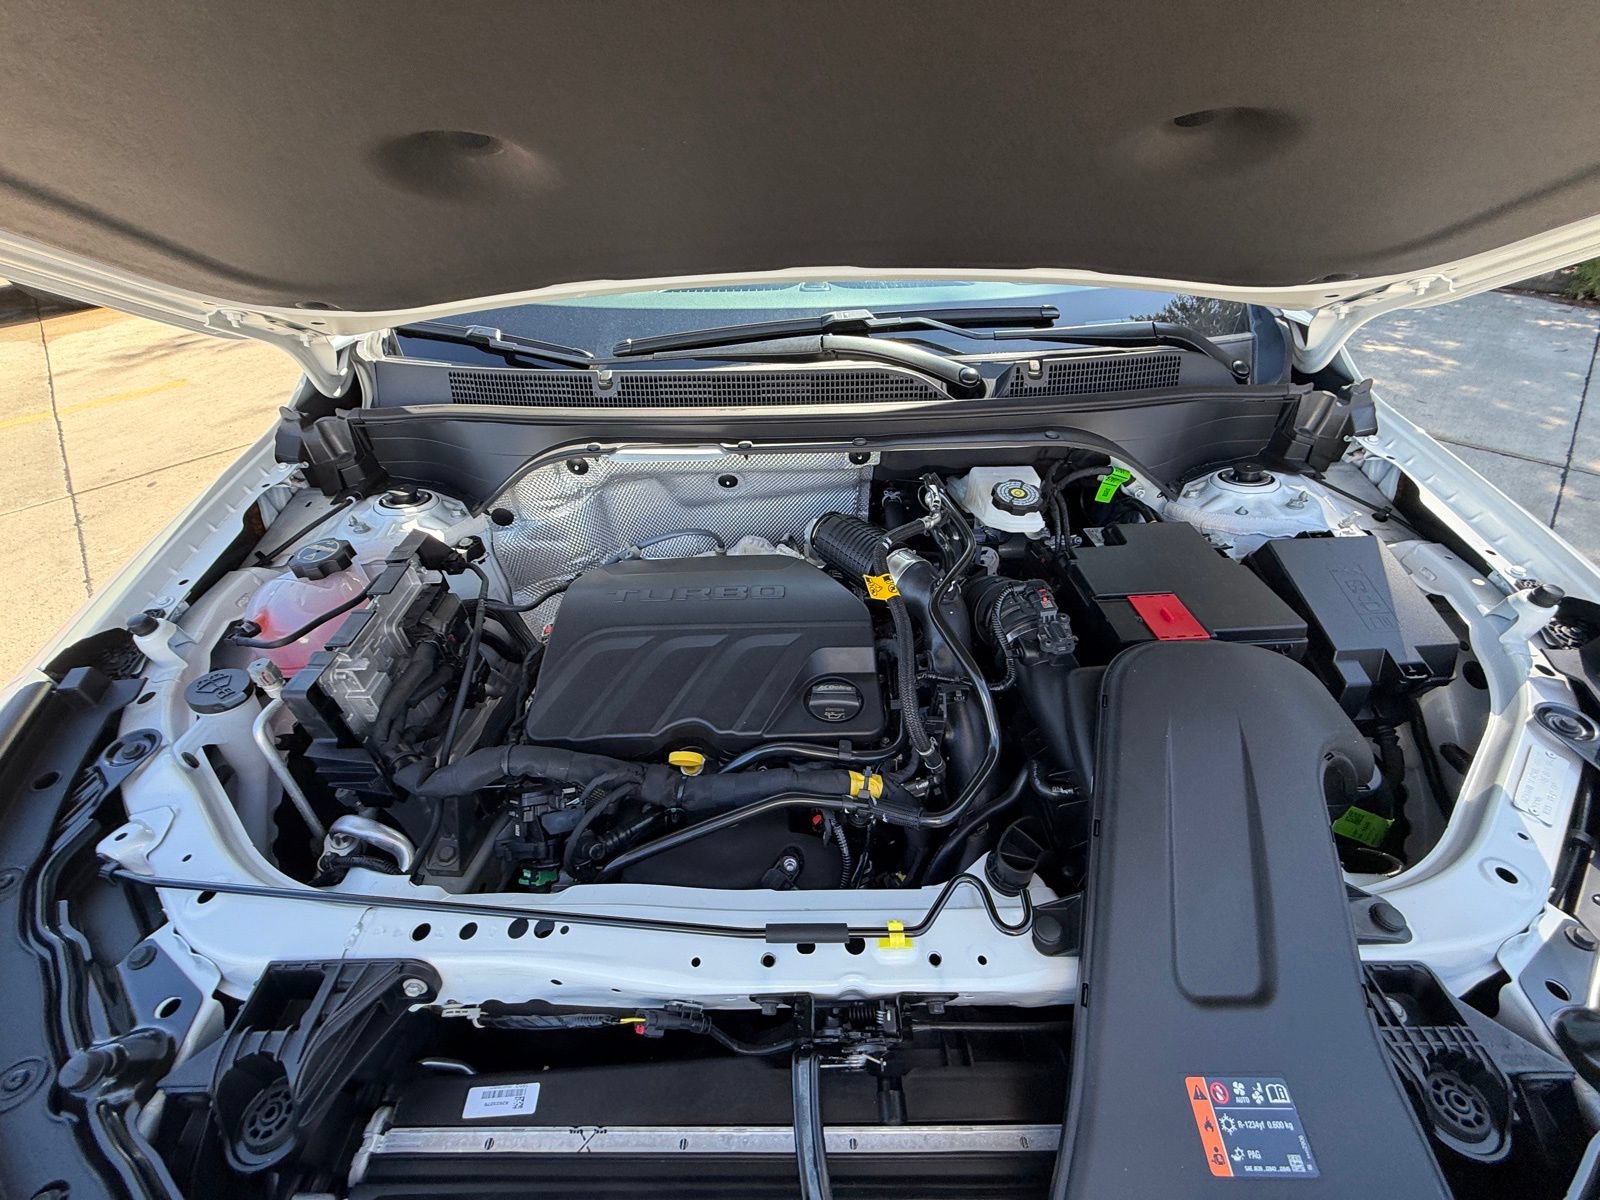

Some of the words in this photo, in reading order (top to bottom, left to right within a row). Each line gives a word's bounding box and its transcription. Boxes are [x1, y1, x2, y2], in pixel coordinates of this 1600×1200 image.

[608, 584, 785, 602] TURBO
[1235, 1096, 1250, 1104] AUTO
[1237, 1120, 1265, 1131] R-1234yf
[1284, 1120, 1294, 1131] kg
[1246, 1149, 1262, 1160] PAG
